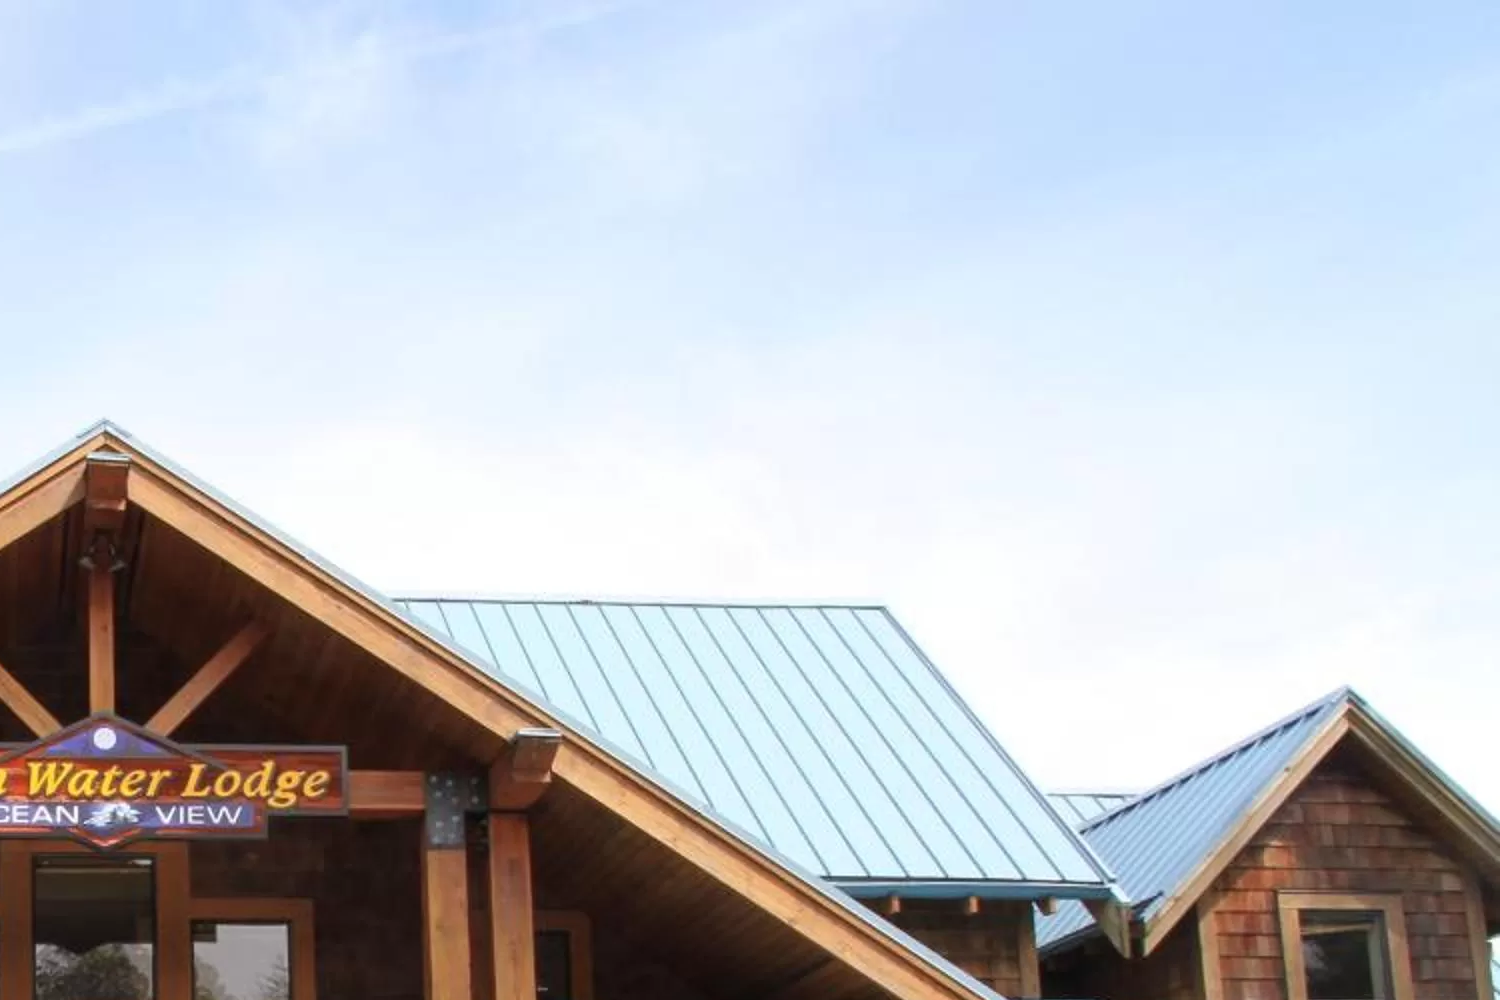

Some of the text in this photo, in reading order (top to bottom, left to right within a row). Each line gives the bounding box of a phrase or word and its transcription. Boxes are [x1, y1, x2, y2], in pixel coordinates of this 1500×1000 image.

[27, 761, 172, 797] Water
[180, 759, 331, 808] Lodge
[155, 804, 243, 825] VIEW
